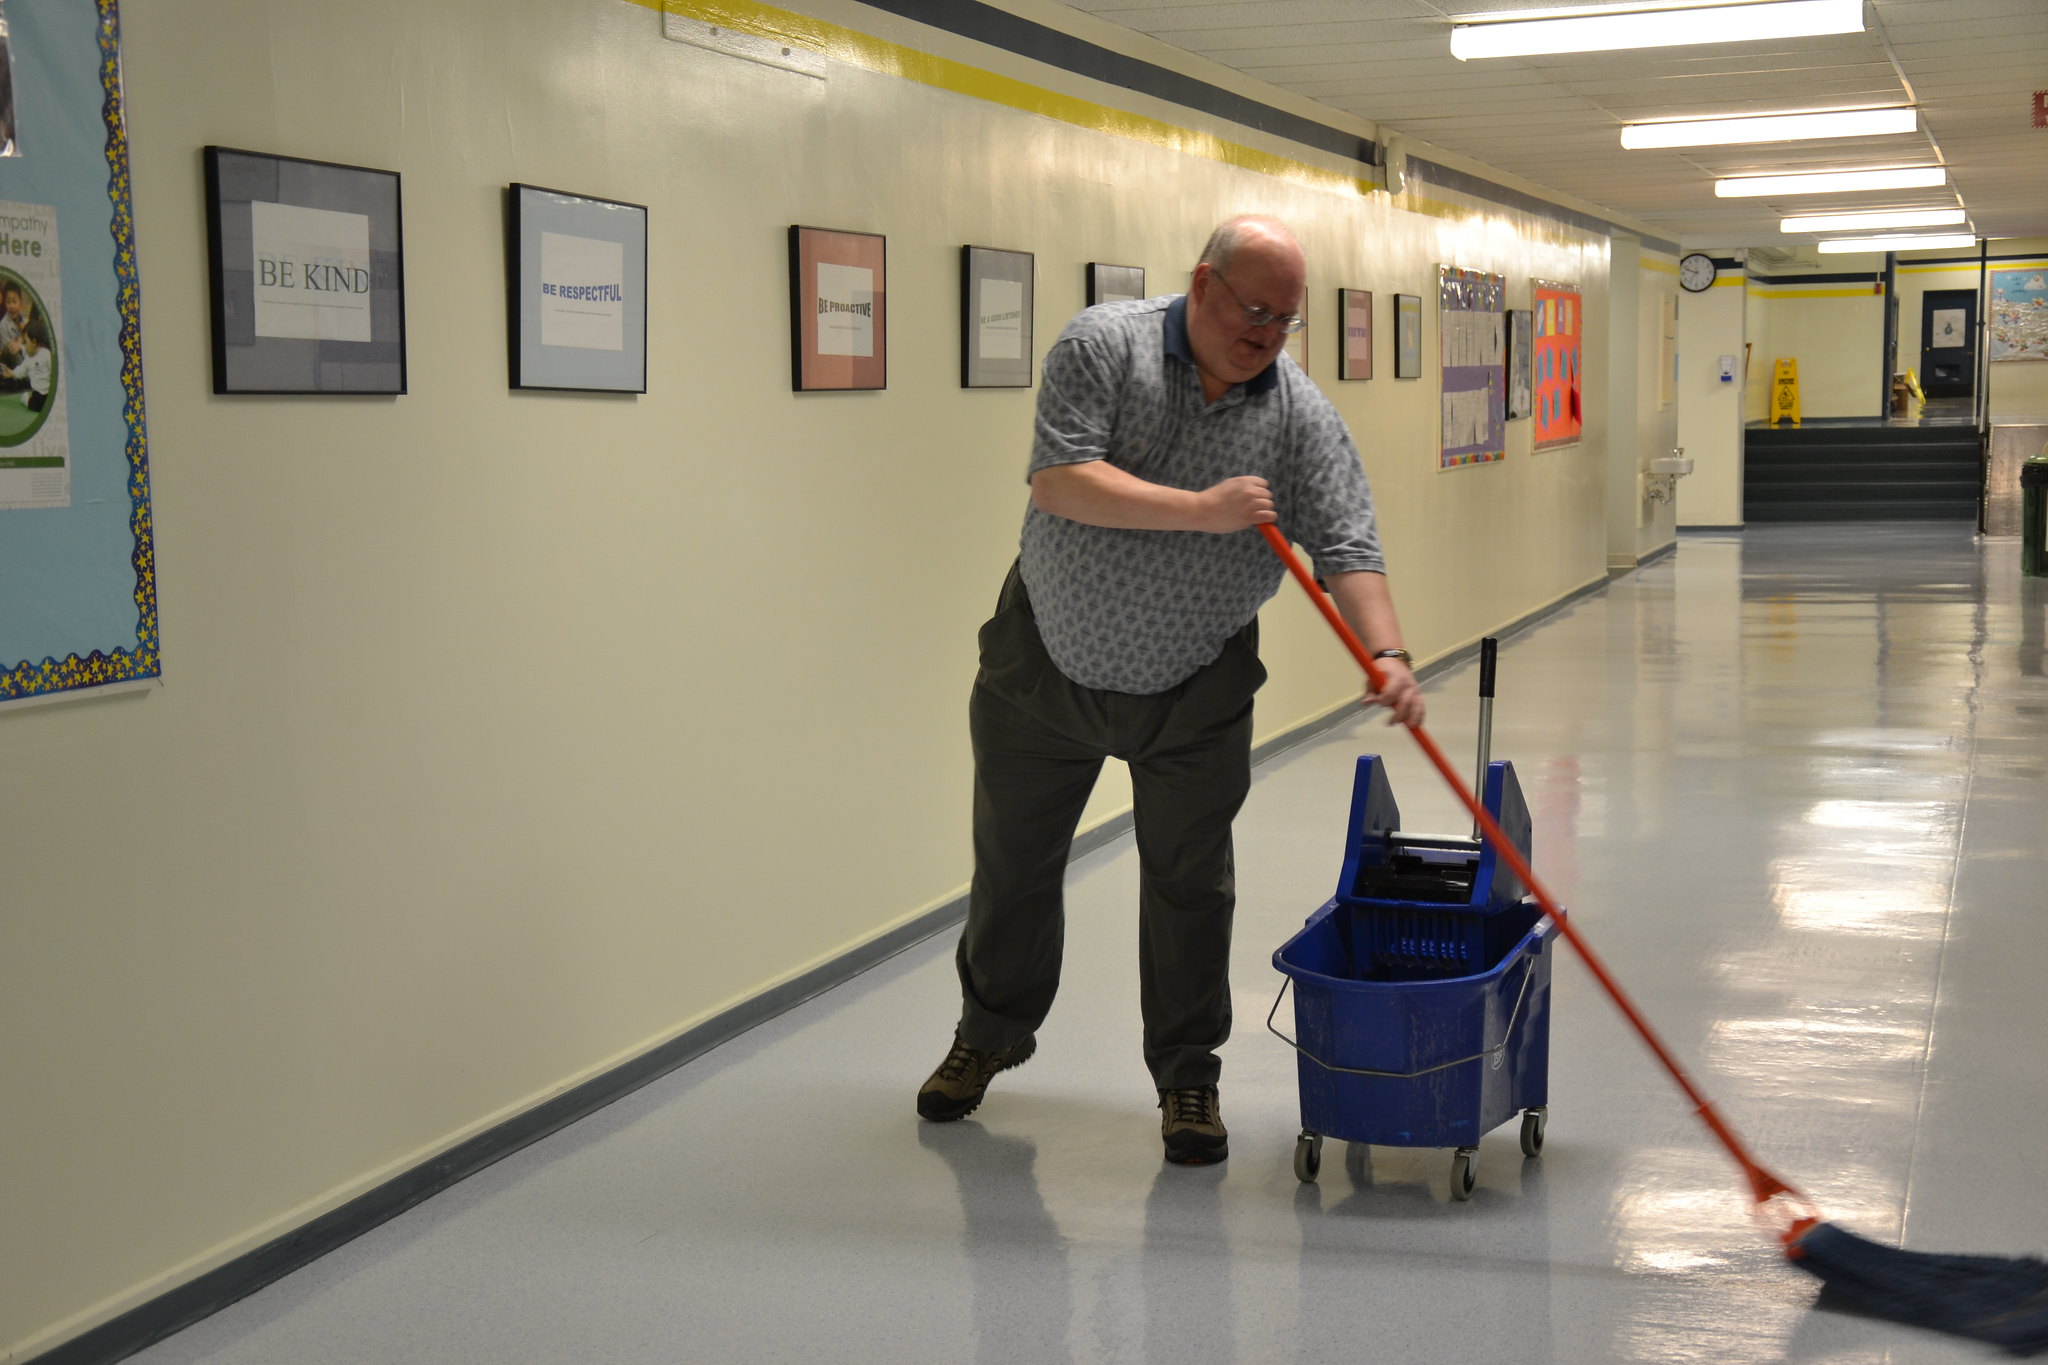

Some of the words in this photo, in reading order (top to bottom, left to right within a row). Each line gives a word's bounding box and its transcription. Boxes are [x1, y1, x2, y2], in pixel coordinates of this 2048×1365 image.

[0, 232, 42, 258] Here
[259, 259, 295, 288] BE
[303, 263, 369, 294] KIND
[543, 283, 557, 296] BE
[559, 283, 622, 302] RESPECTFUL
[818, 297, 829, 314] BE
[829, 302, 871, 318] PROACTIVE
